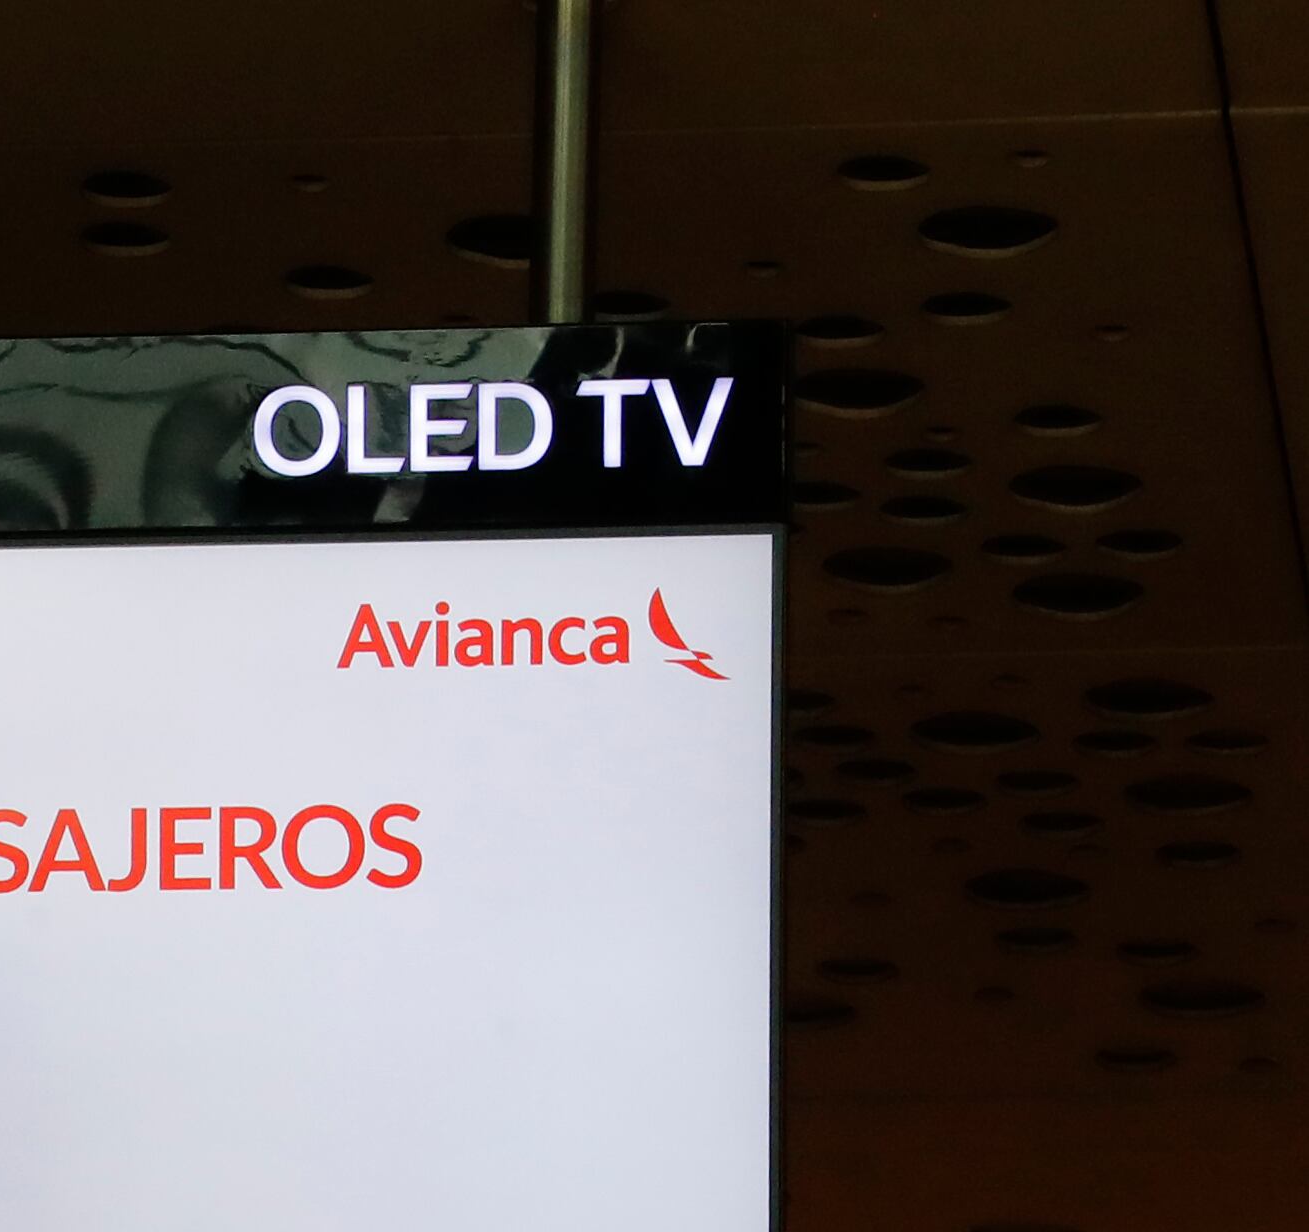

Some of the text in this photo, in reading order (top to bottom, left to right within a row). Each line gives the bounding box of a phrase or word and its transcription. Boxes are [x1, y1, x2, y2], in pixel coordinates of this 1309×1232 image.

[253, 376, 734, 477] OLED TV
[336, 601, 630, 669] Avianca
